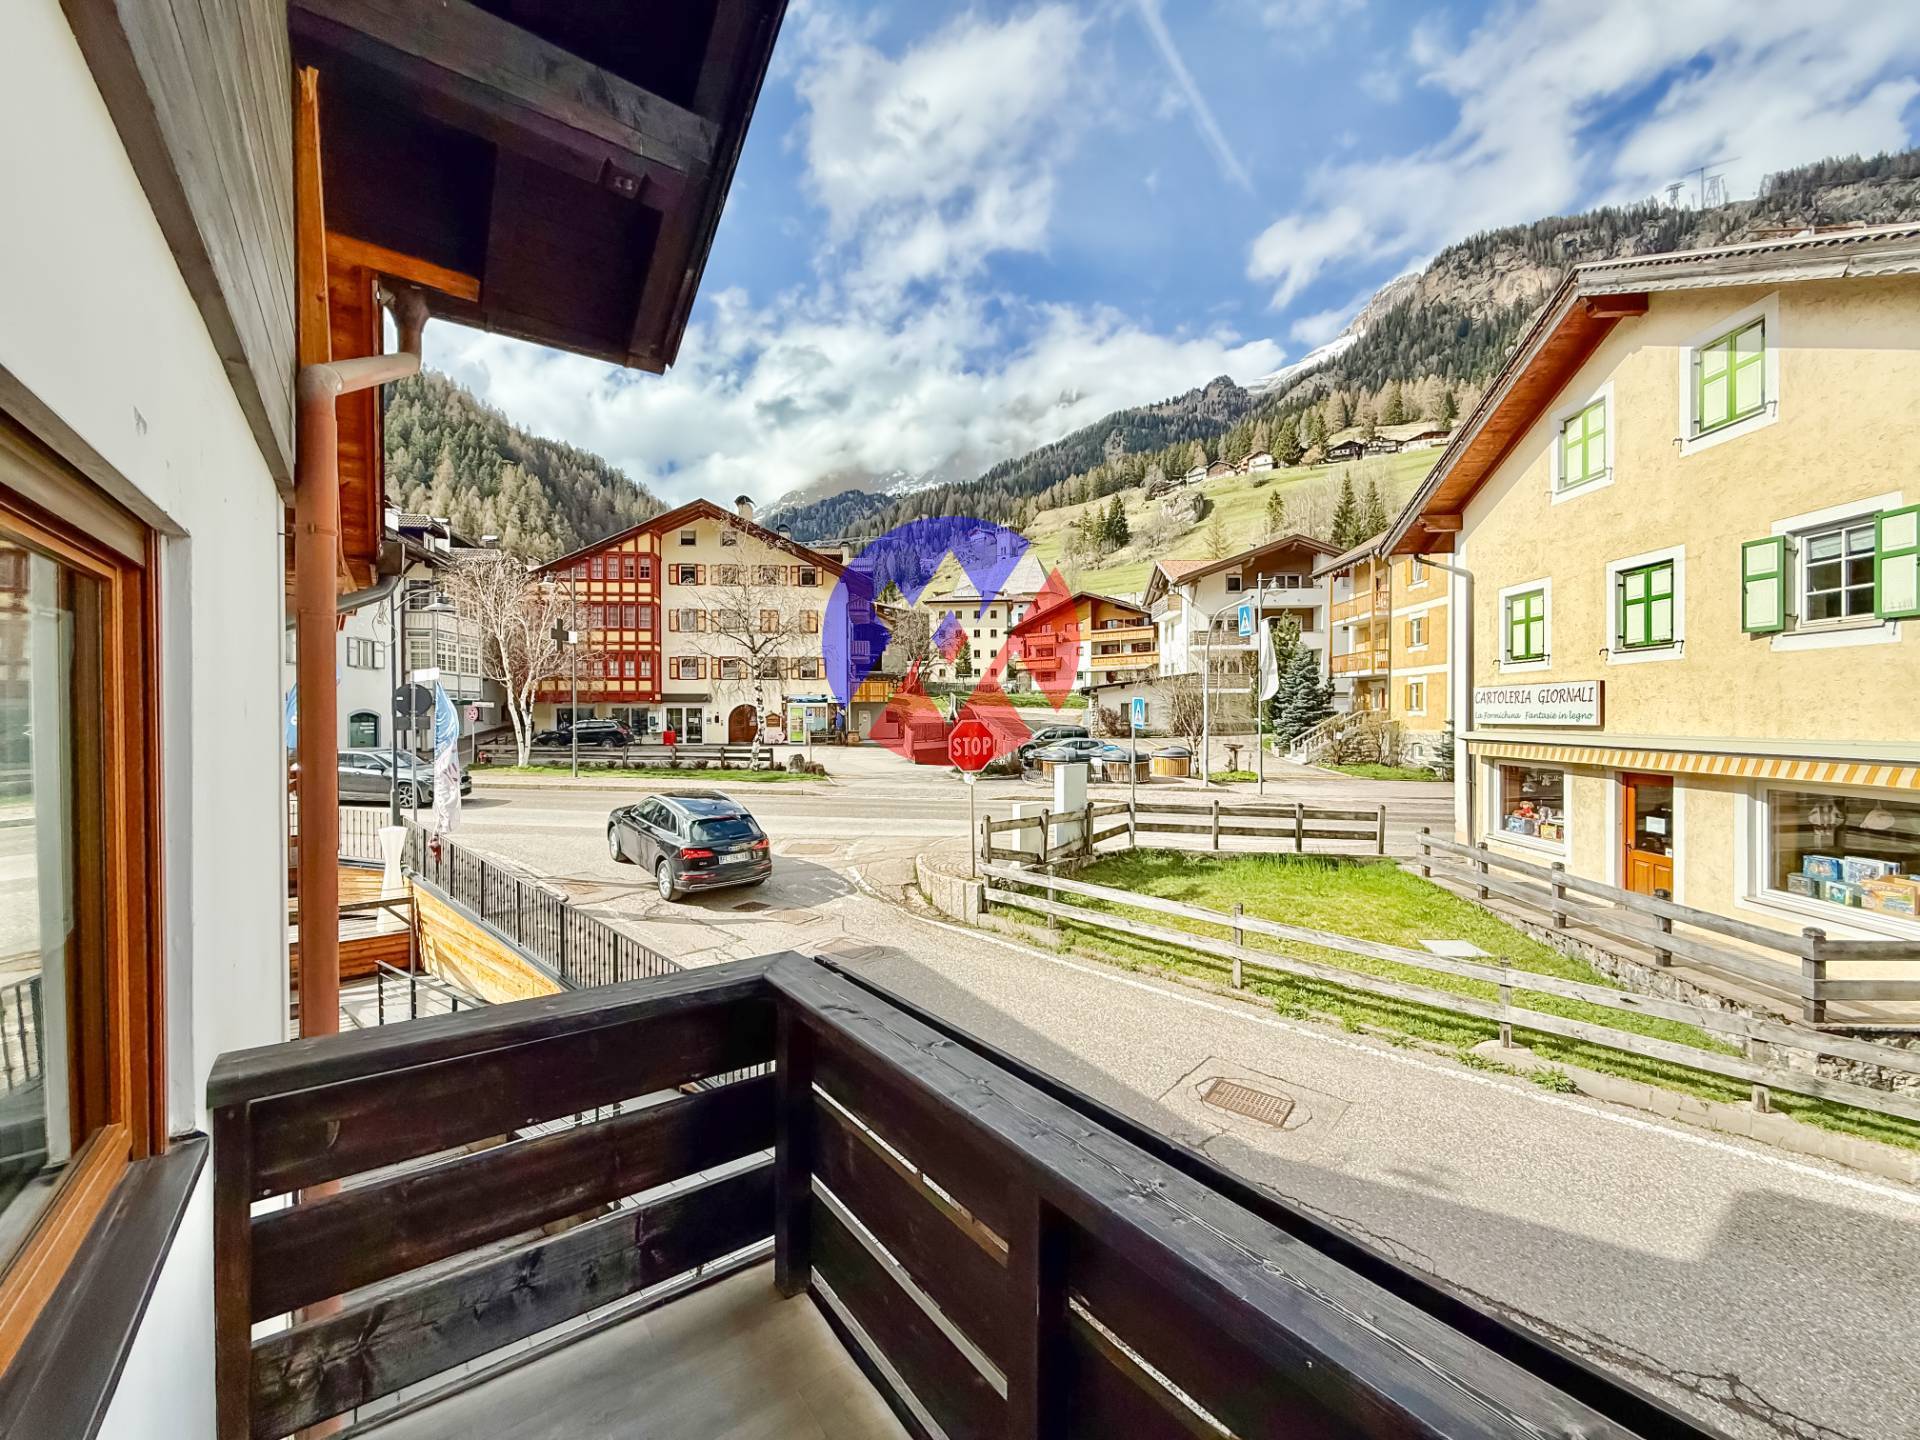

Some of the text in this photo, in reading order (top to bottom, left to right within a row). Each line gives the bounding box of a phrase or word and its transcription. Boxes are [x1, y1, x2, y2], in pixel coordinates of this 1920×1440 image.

[1475, 687, 1594, 705] CARTOLERIA GIORNALI
[1525, 711, 1557, 720] Fantasie
[1558, 711, 1567, 720] in
[1569, 710, 1594, 722] legno
[952, 736, 992, 757] STOP
